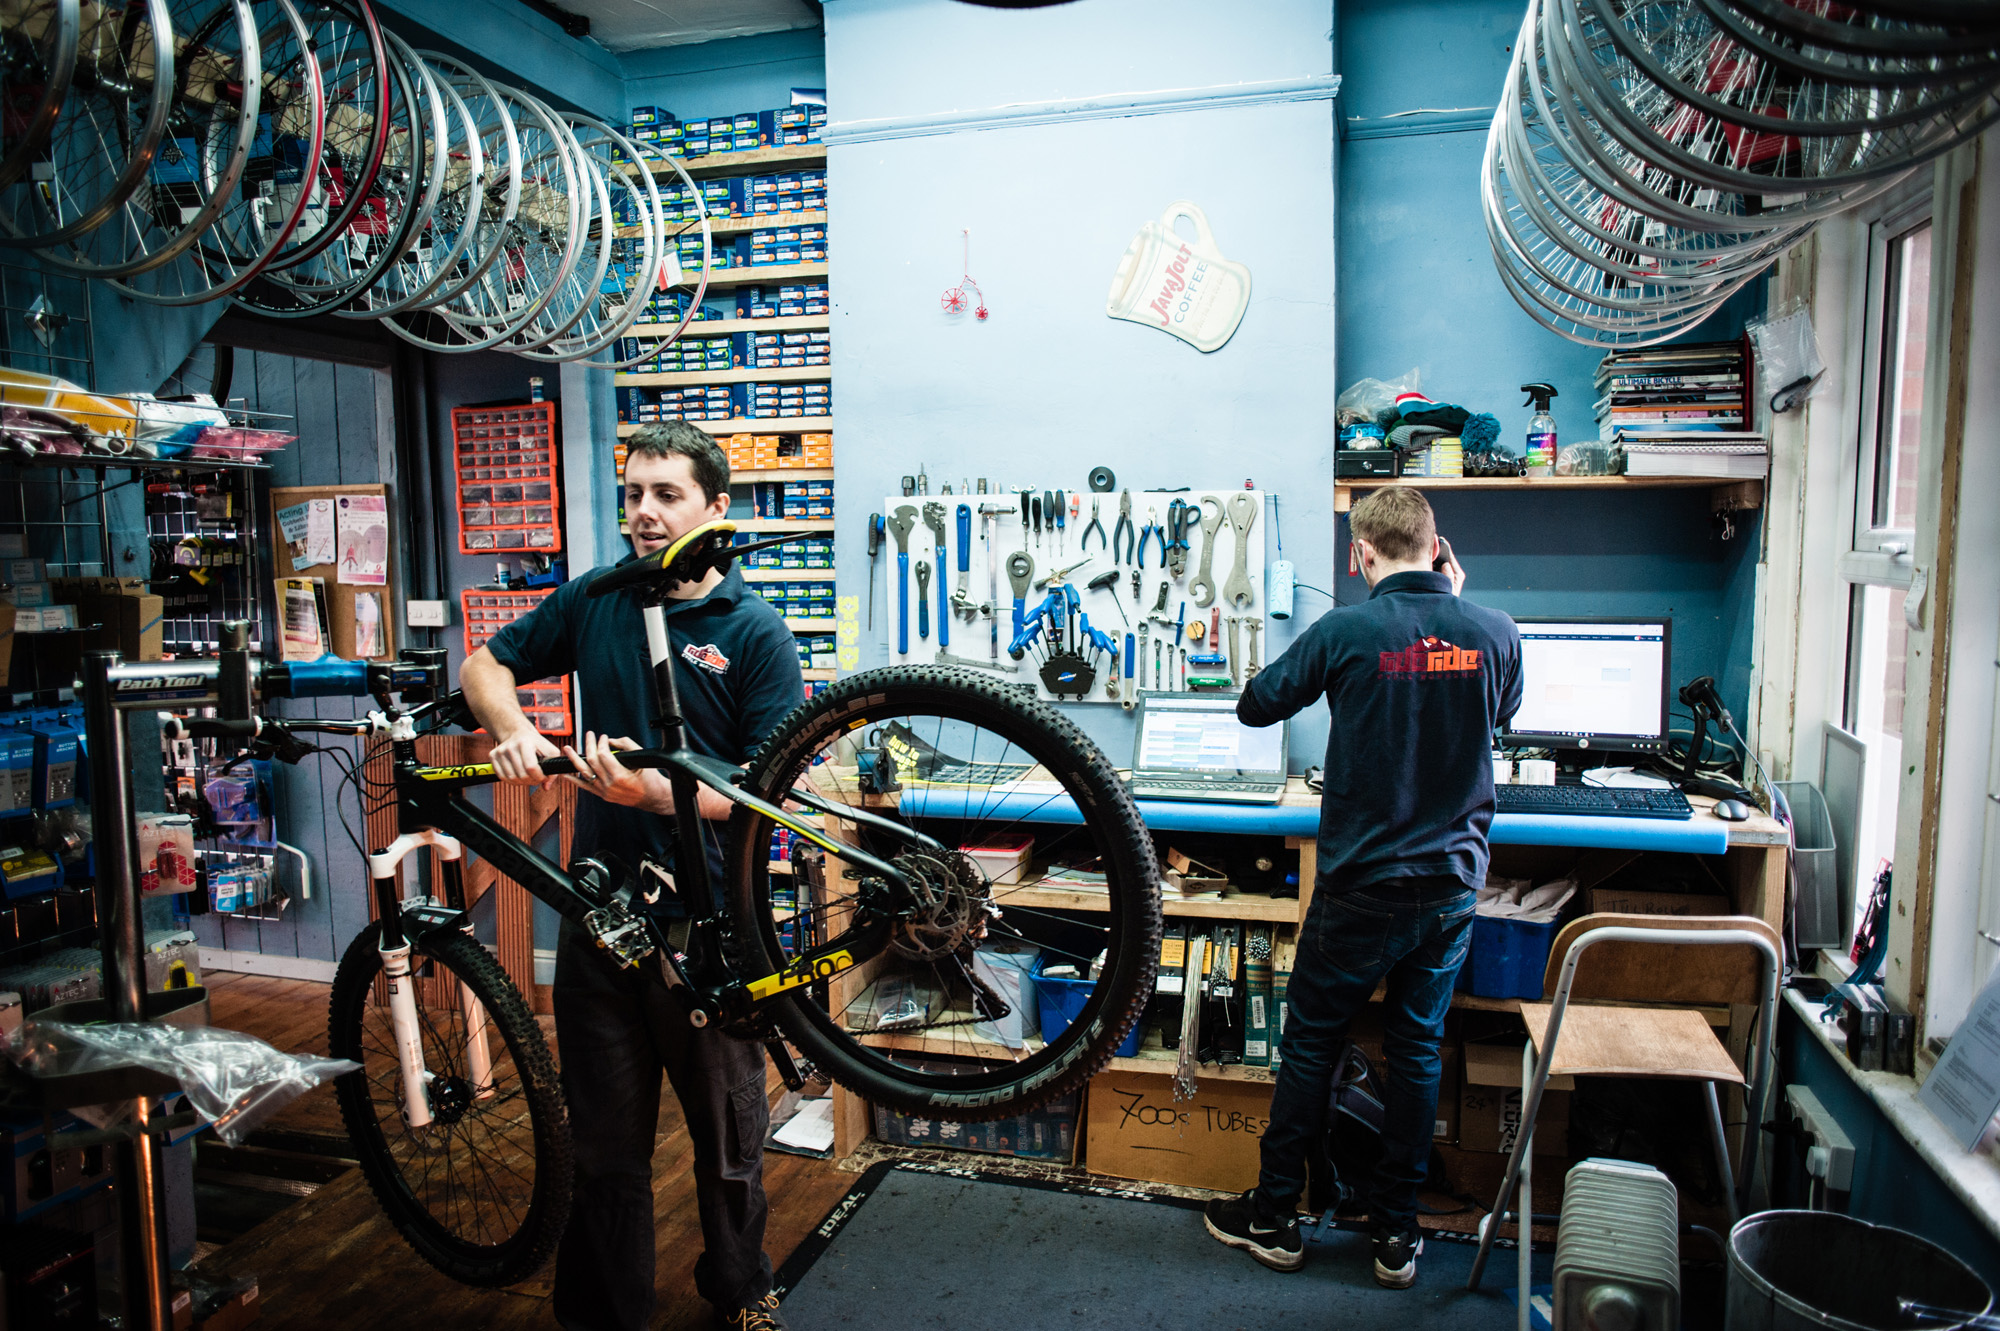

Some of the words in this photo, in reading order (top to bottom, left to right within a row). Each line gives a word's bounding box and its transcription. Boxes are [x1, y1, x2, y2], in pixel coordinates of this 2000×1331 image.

[1174, 262, 1209, 323] COFFEE
[1618, 378, 1652, 386] ULTIMATE
[1653, 376, 1682, 384] BICYCLE
[279, 508, 303, 520] Acting
[117, 677, 162, 691] Park
[164, 675, 206, 687] Tool
[758, 692, 886, 792] SCHWALBE
[157, 947, 180, 960] AZTEC
[54, 987, 79, 1003] AZTEC
[928, 1085, 1015, 1109] RACING
[1022, 1036, 1090, 1095] RALPH
[1200, 1105, 1270, 1139] TUBES
[817, 1191, 866, 1239] IDEAL
